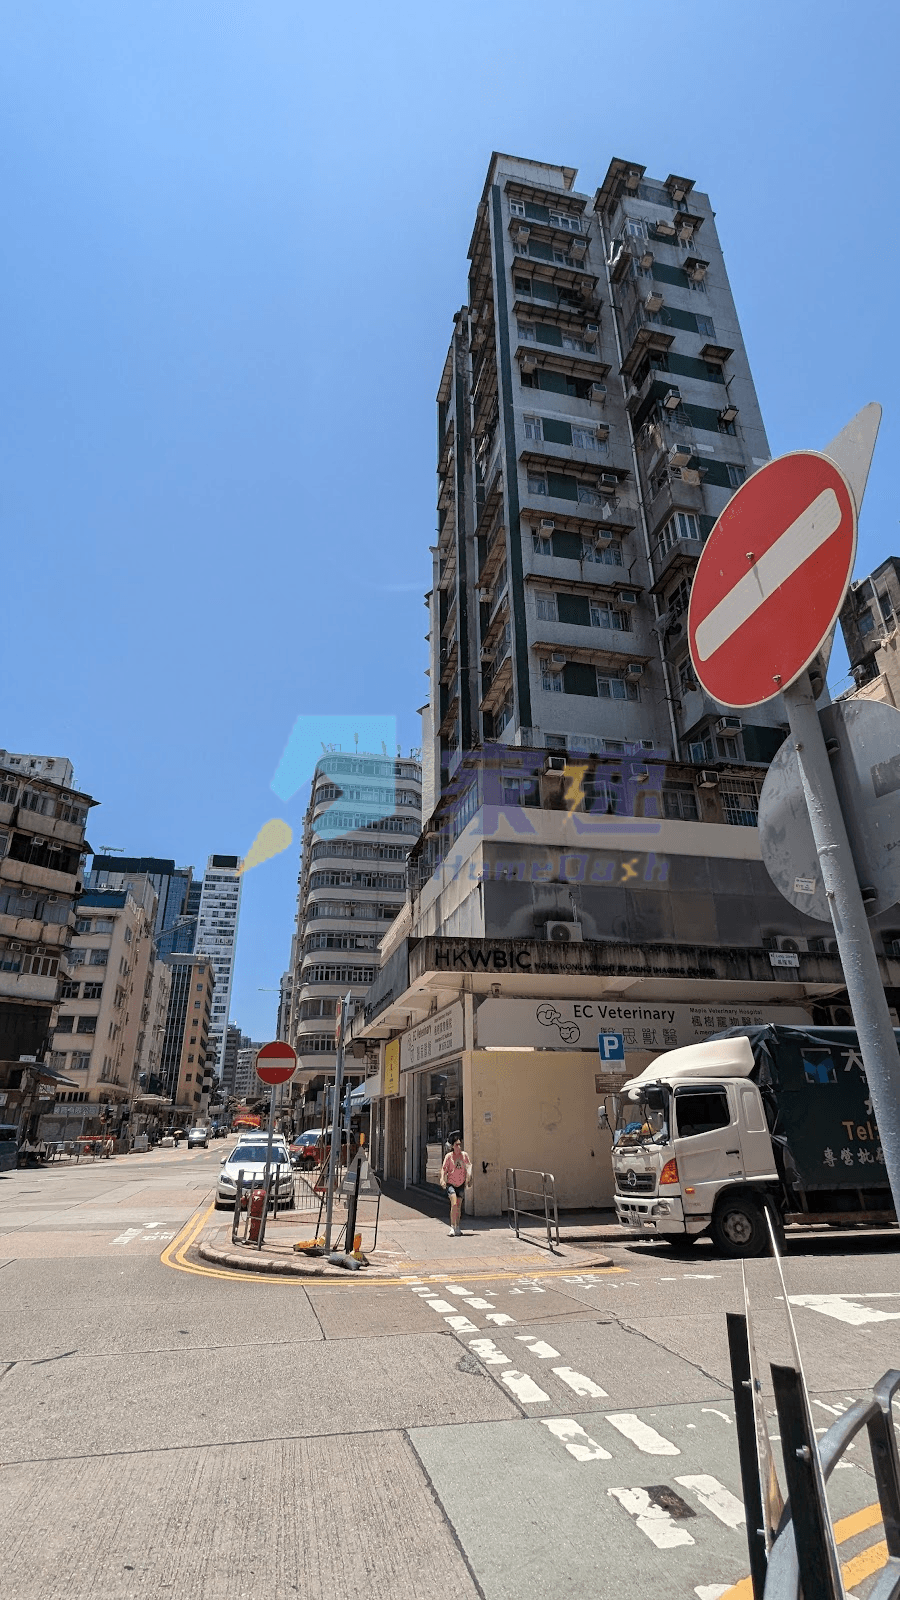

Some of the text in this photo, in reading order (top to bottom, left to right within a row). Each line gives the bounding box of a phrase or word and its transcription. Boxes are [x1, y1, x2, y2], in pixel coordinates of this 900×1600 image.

[435, 948, 532, 969] HKWBIC
[534, 961, 561, 970] HONG
[561, 962, 583, 971] KONG
[573, 1004, 676, 1024] EC Veterinary
[603, 1036, 619, 1058] P
